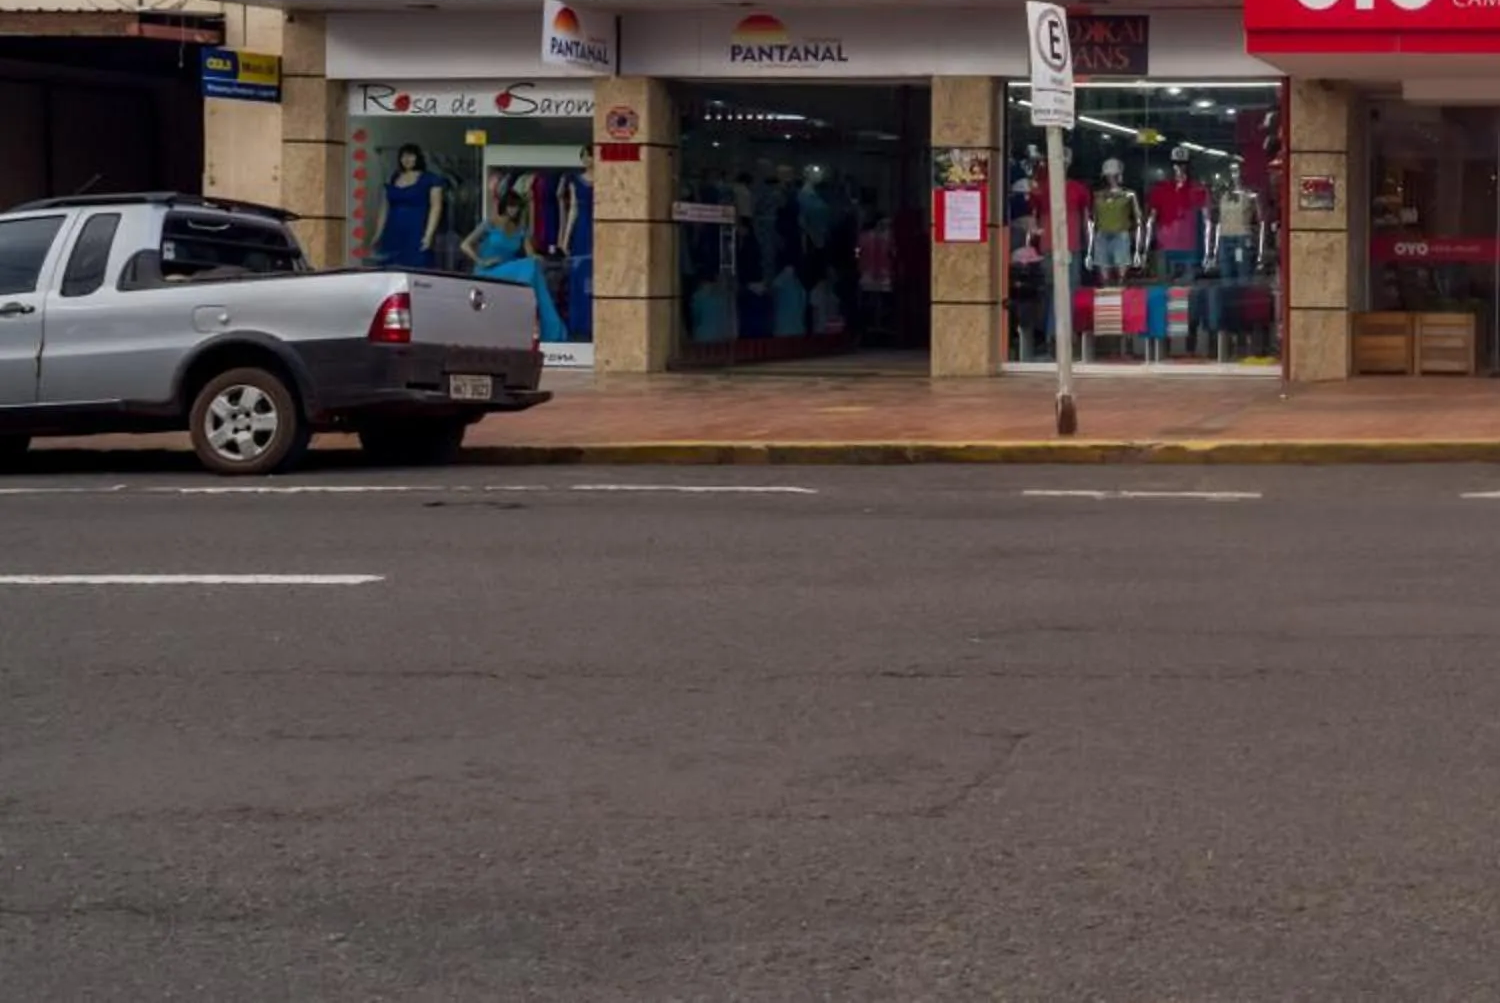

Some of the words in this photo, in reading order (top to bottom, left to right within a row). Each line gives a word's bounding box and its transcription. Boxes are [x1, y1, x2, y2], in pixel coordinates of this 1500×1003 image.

[551, 36, 609, 65] PANTANAL
[1048, 20, 1062, 60] E
[730, 43, 849, 63] PANTANAL
[1072, 44, 1130, 70] ANS
[452, 94, 478, 114] de
[1394, 242, 1429, 256] OYO
